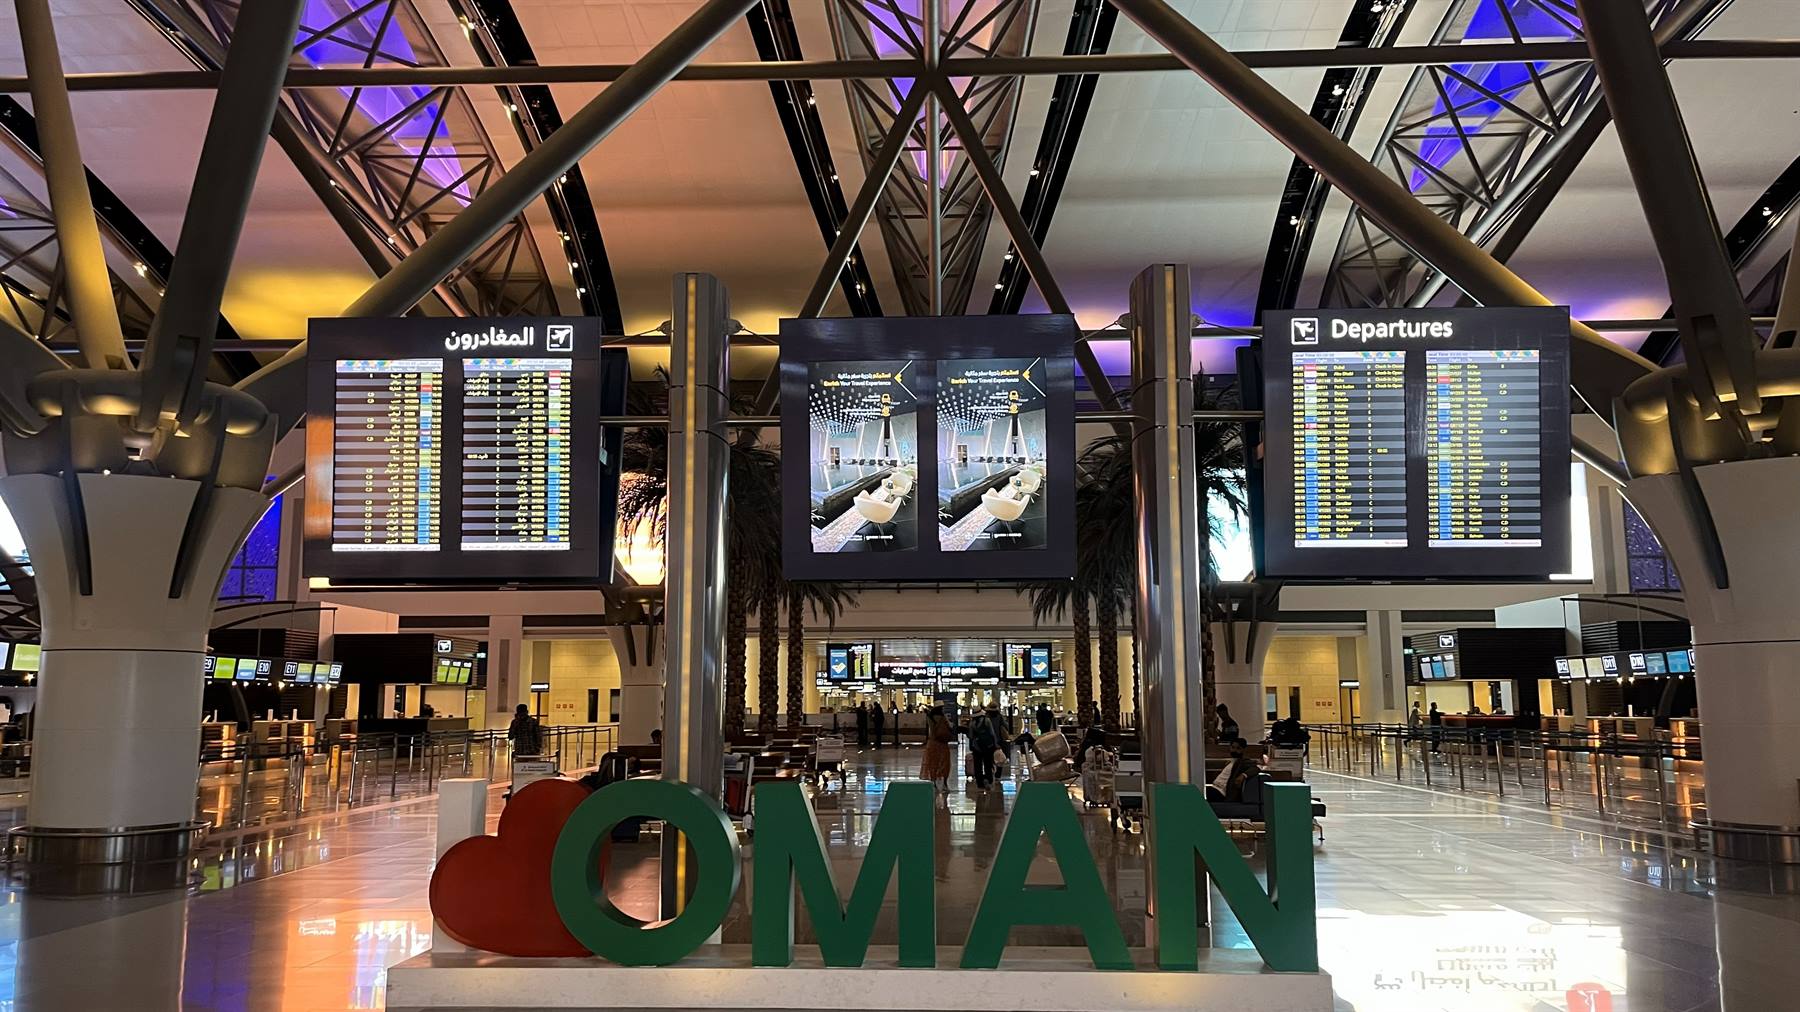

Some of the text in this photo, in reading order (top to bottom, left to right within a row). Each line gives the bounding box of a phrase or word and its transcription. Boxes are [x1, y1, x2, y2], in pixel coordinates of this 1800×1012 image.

[445, 326, 534, 351] المغادرون
[1330, 319, 1453, 343] Departures
[260, 664, 270, 672] E10
[286, 664, 296, 674] E11
[1632, 657, 1644, 667] D10
[552, 780, 1318, 972] OMAN
